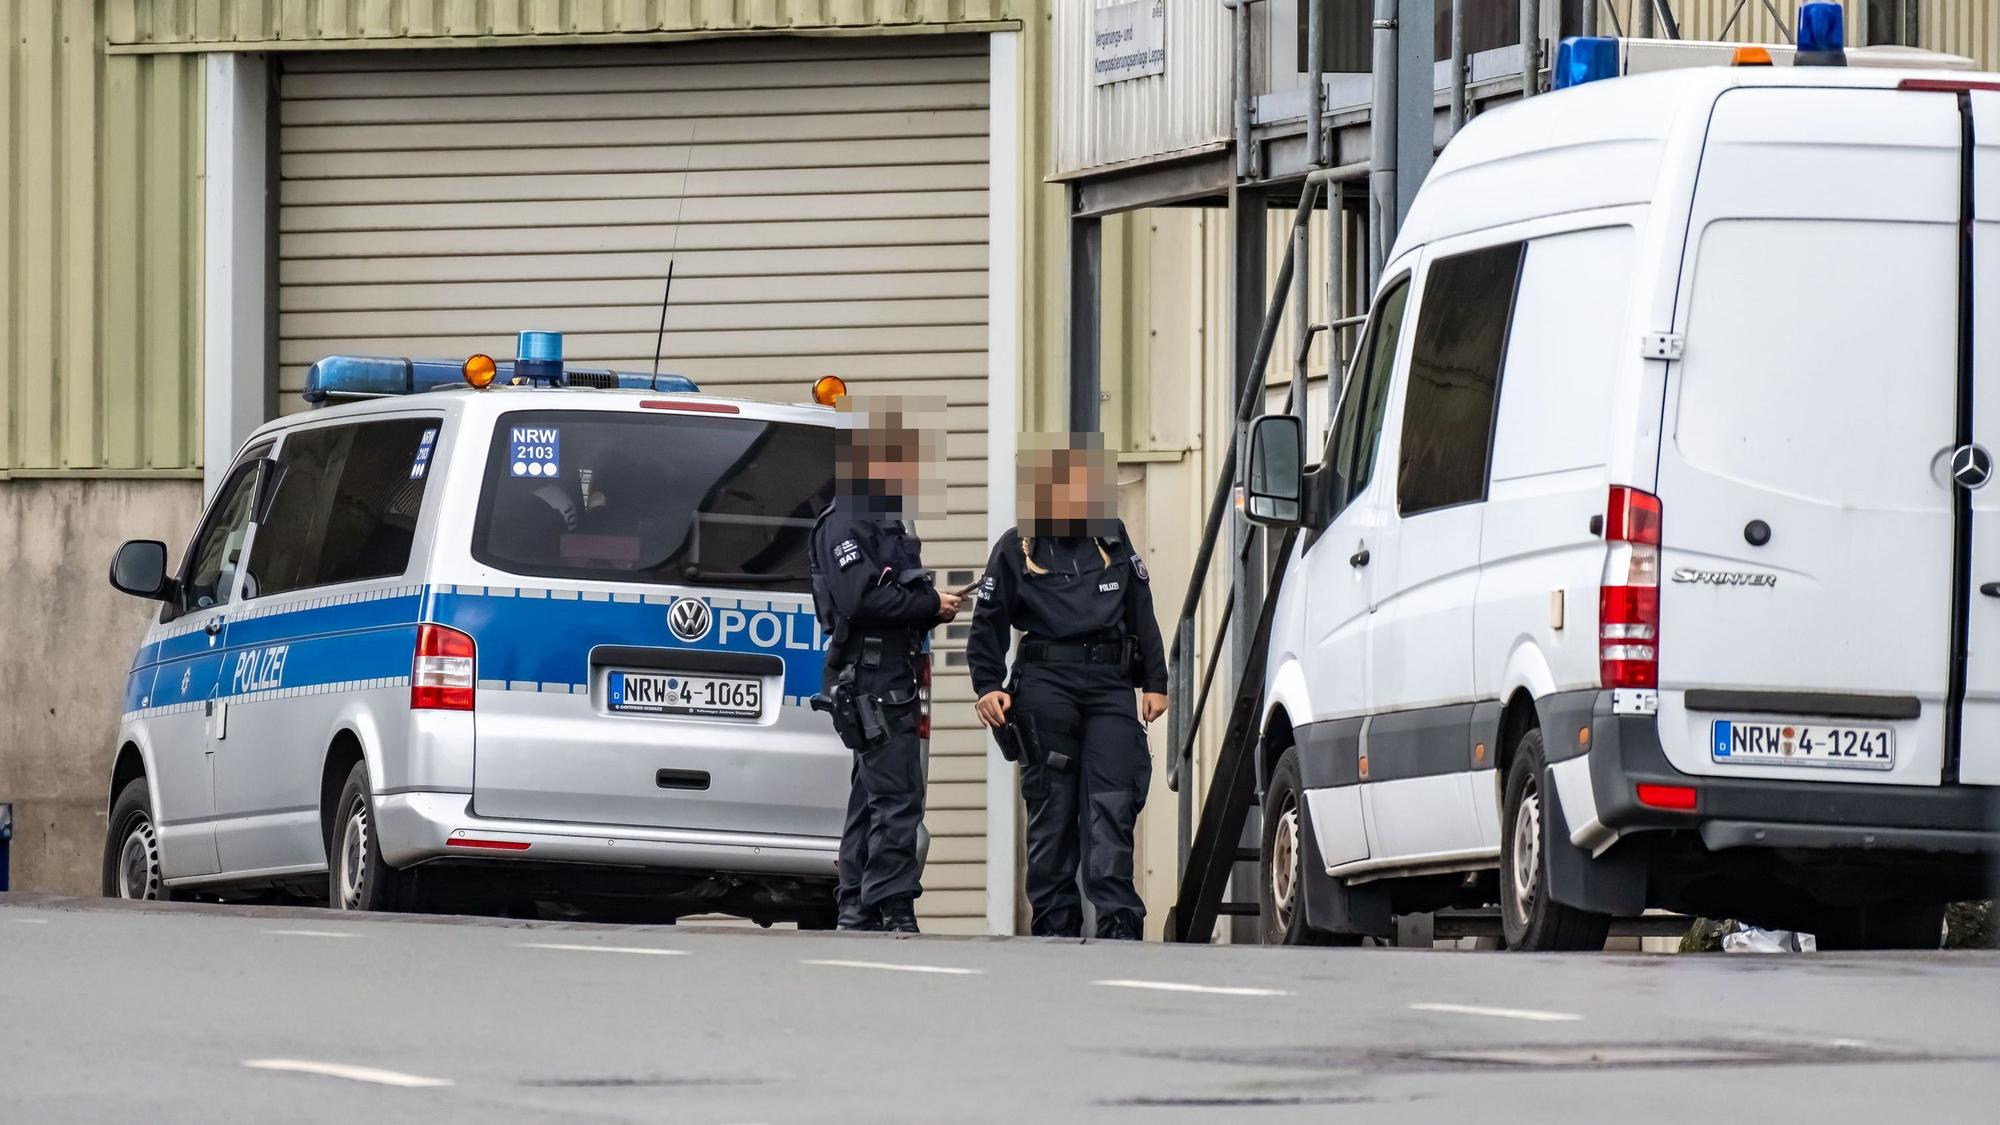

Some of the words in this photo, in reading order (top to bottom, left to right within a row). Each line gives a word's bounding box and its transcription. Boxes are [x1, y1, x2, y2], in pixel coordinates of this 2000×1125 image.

[1124, 24, 1133, 41] und
[513, 429, 557, 443] NRW
[517, 446, 553, 459] 2103
[839, 551, 857, 567] BAT
[1099, 582, 1120, 592] POLIZEI
[719, 610, 833, 651] POLI
[232, 645, 290, 694] POLIZEI
[624, 677, 666, 702] NRW
[680, 681, 758, 707] 4-1065
[1720, 743, 1726, 751] D
[1732, 726, 1780, 753] NRW
[1799, 728, 1889, 758] 4-1241
